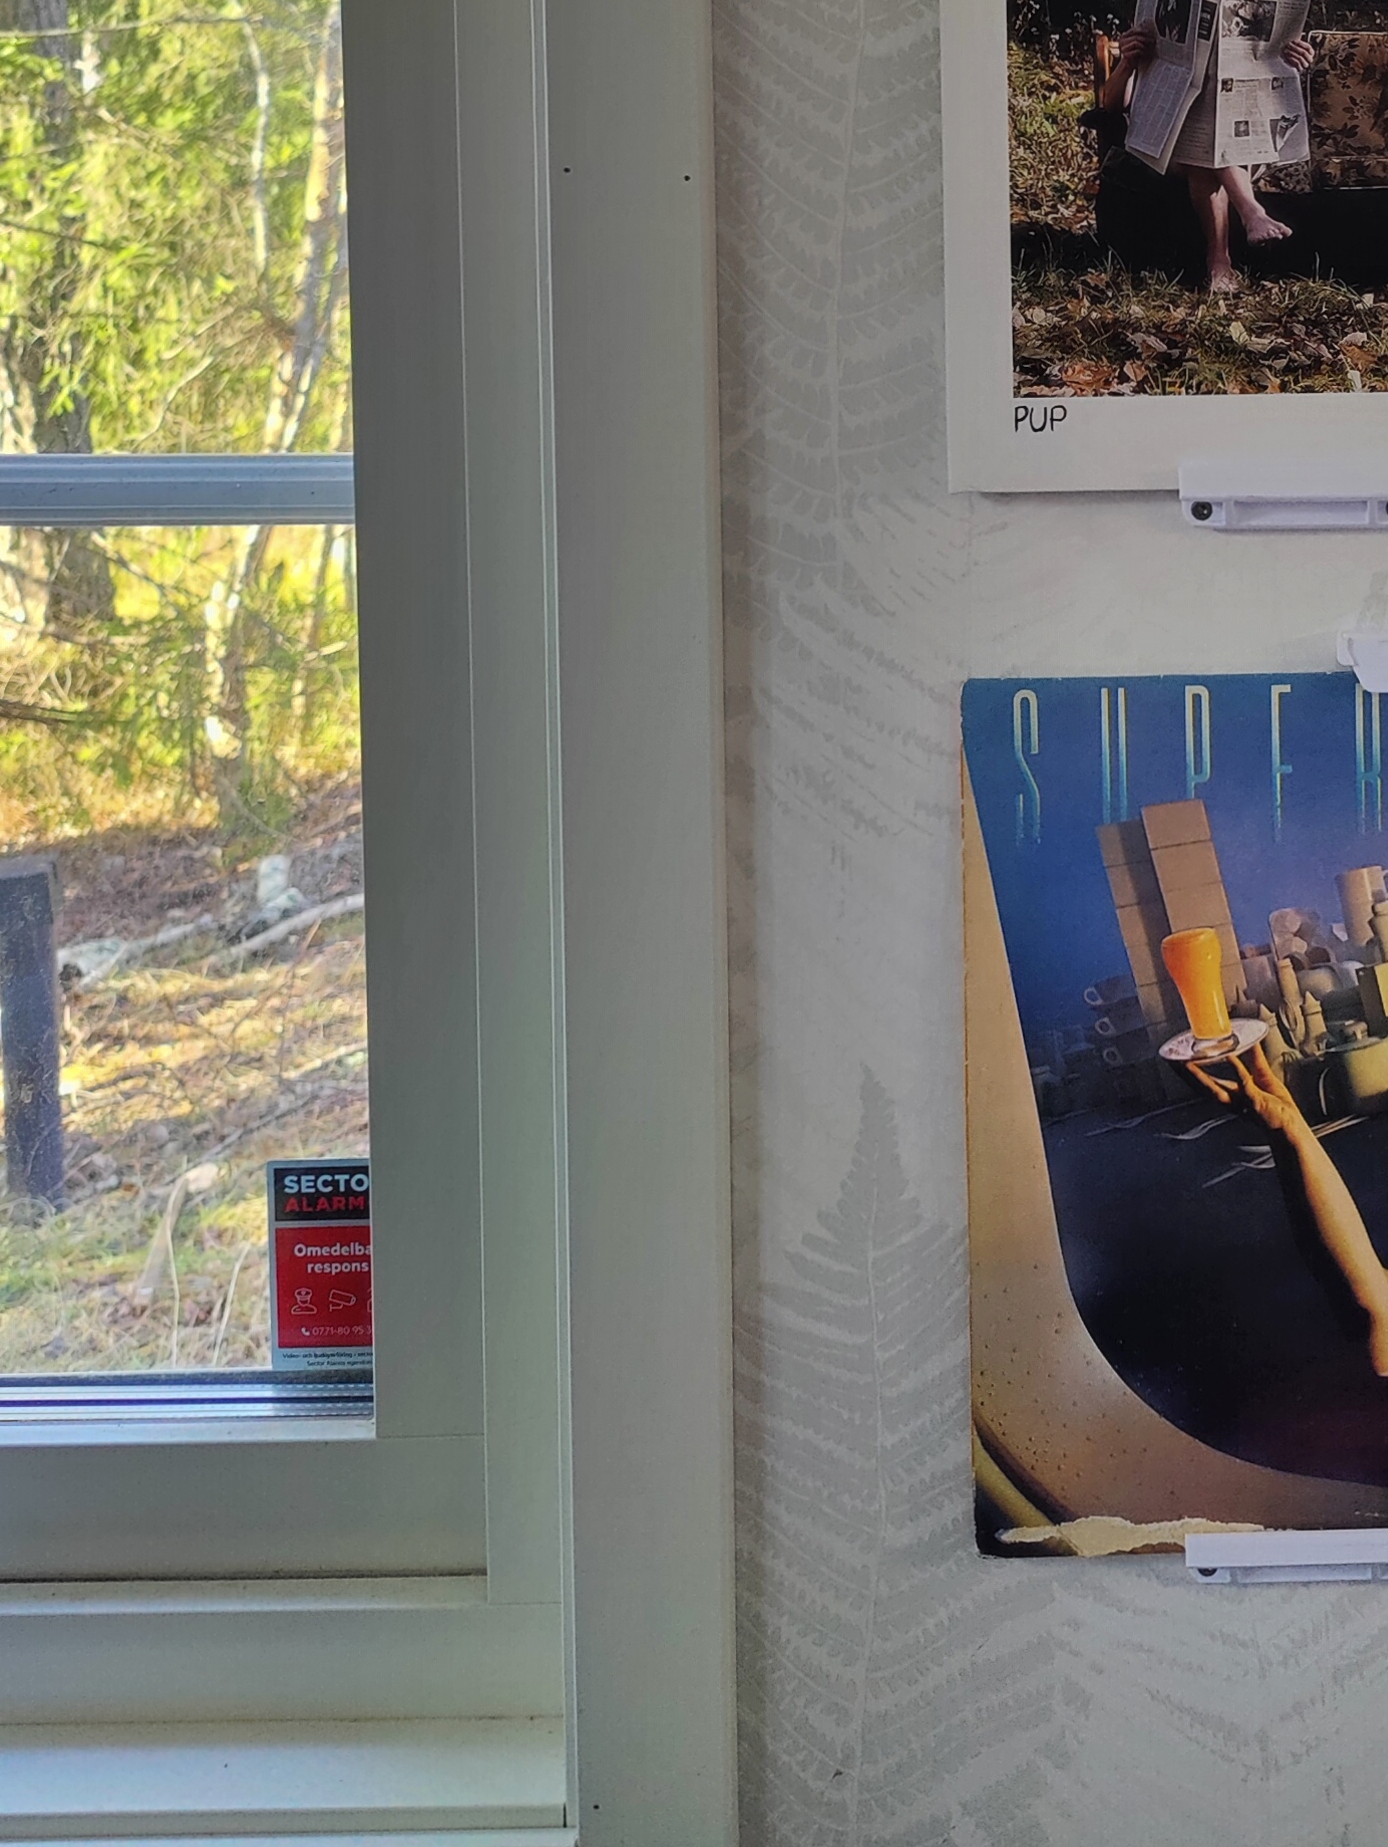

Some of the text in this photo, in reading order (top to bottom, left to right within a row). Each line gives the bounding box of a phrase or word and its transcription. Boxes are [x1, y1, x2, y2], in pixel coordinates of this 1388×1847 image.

[1014, 404, 1067, 433] PUP
[284, 1196, 365, 1213] ALARM
[307, 1261, 369, 1275] respons
